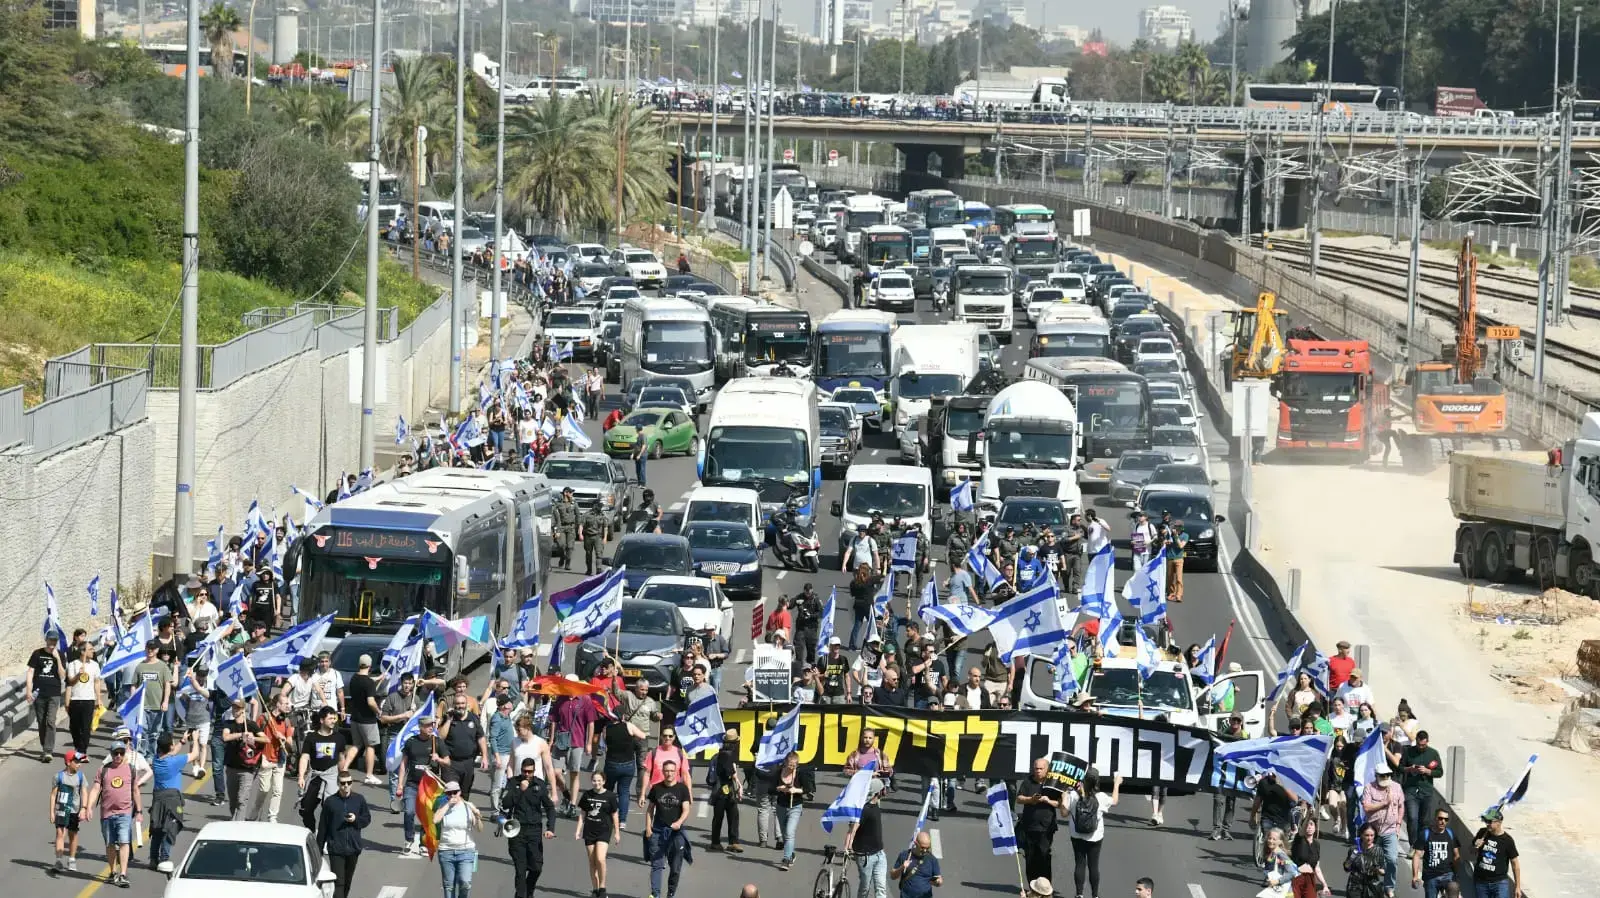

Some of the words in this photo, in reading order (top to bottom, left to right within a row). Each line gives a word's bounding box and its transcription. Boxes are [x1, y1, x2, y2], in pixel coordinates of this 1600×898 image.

[1441, 404, 1483, 412] DOOSAN
[336, 531, 353, 547] 116
[1001, 720, 1210, 785] להתנגד
[1051, 760, 1077, 776] חינוך
